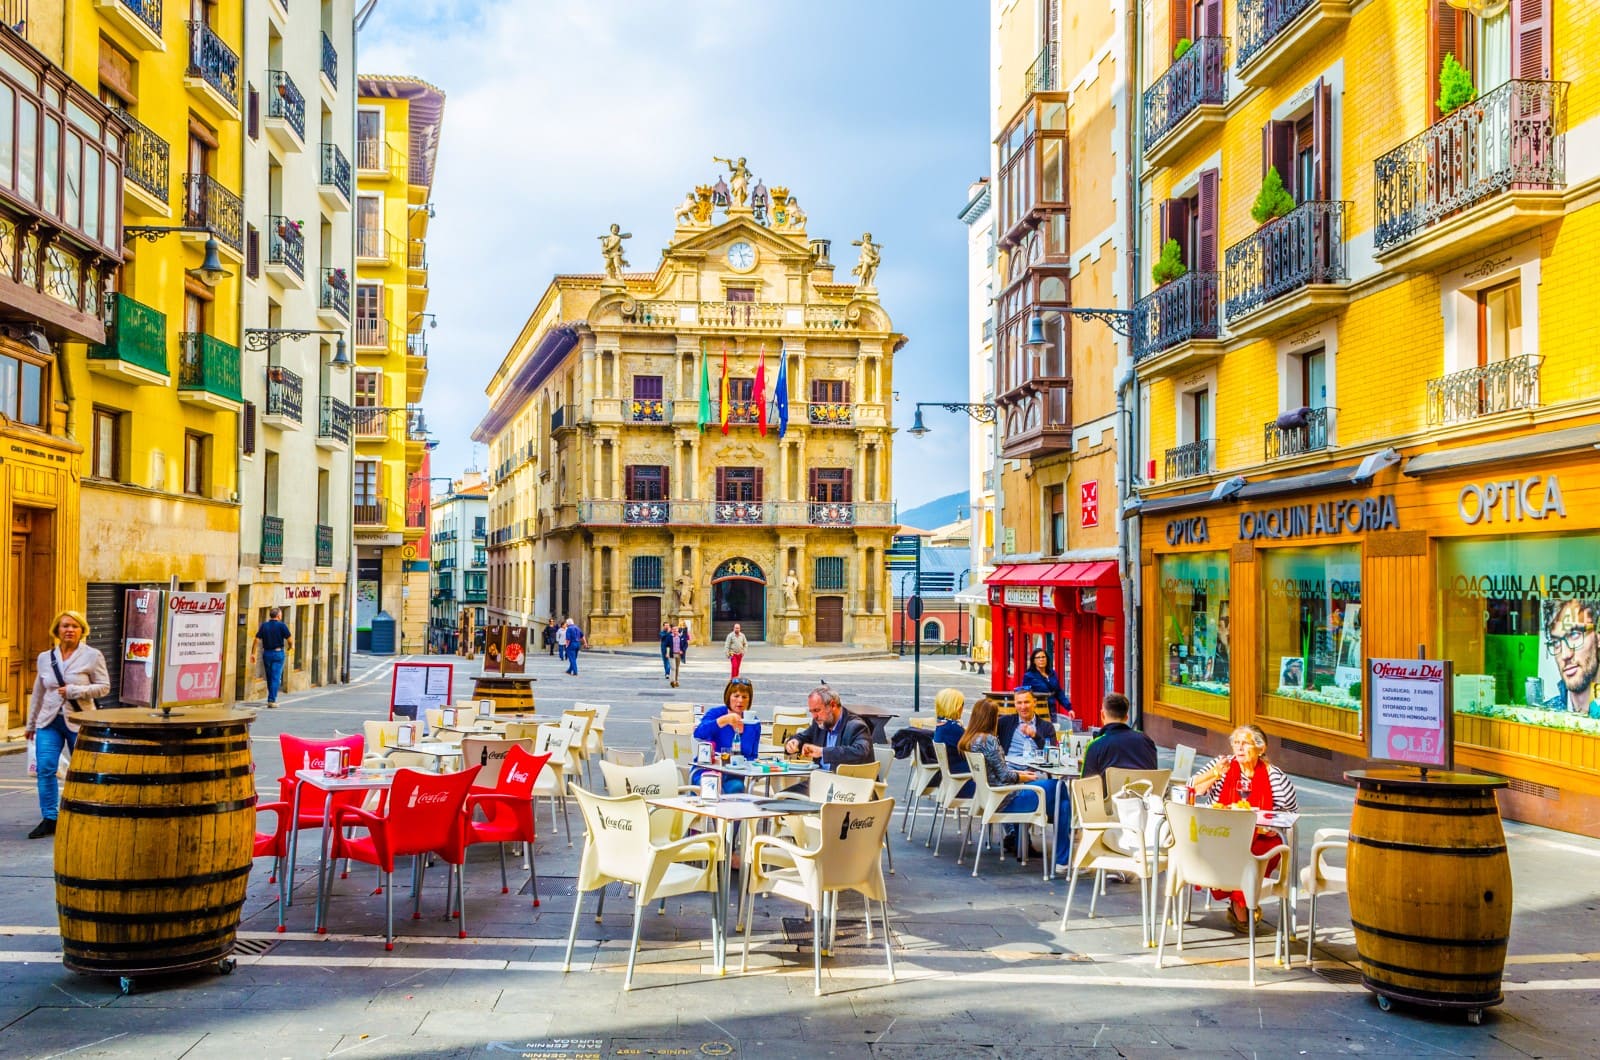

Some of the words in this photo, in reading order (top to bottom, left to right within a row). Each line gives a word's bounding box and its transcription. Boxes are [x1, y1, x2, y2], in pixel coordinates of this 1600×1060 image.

[1458, 475, 1567, 525] OPTICA
[1165, 516, 1210, 545] OPTICA
[1239, 505, 1313, 540] JOAQUIN
[1314, 495, 1400, 534] ALFORJA
[285, 586, 294, 599] The
[170, 596, 198, 613] Oferta
[1373, 662, 1407, 678] Oferta
